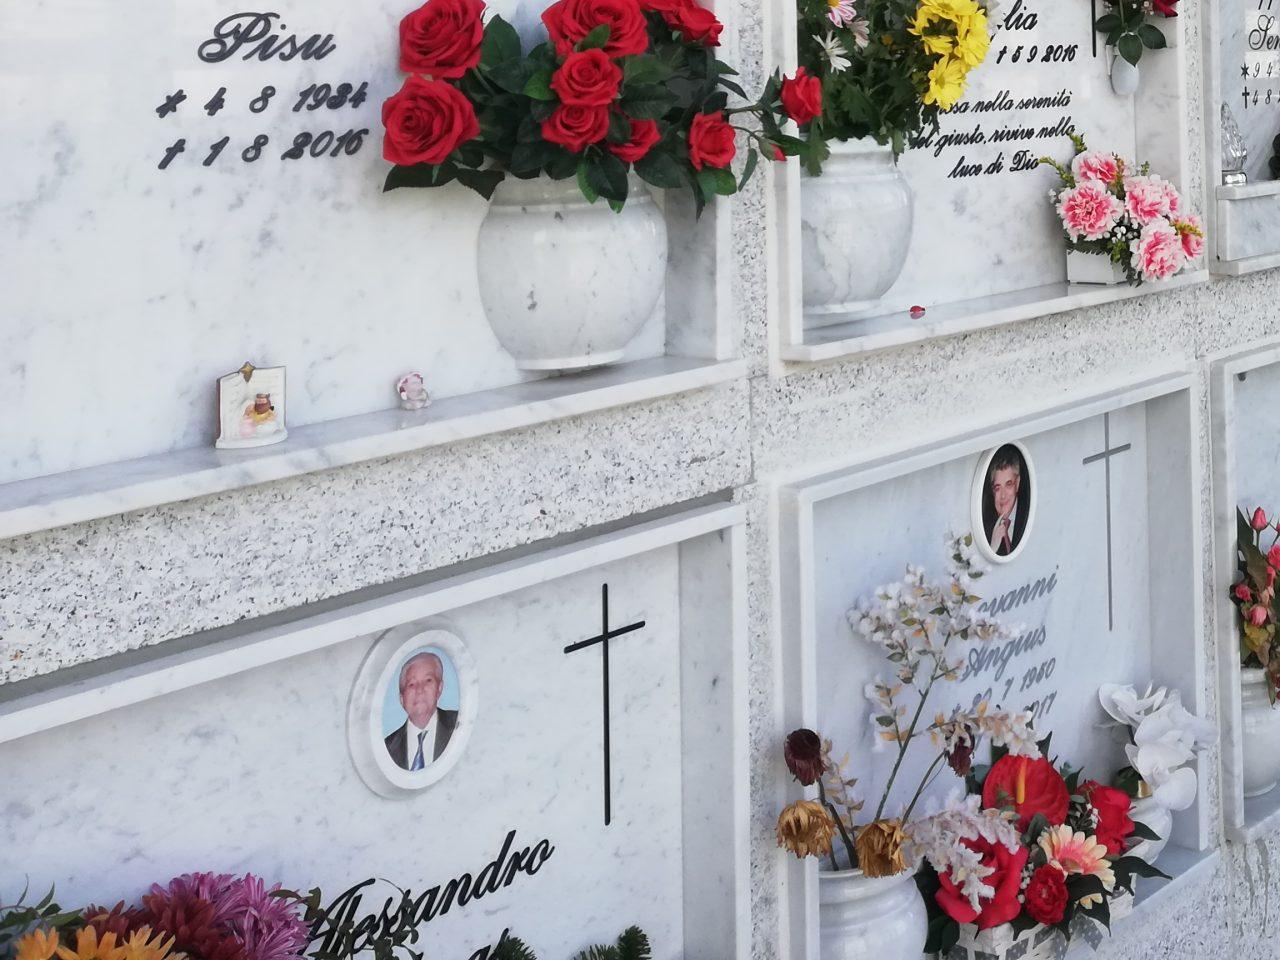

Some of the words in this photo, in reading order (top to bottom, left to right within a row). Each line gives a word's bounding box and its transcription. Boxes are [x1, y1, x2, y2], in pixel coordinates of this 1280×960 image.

[197, 12, 337, 64] Pisu
[1012, 45, 1025, 63] 5
[1026, 45, 1038, 64] 9
[1041, 44, 1079, 63] 2016
[1253, 61, 1261, 78] 9
[1266, 62, 1274, 78] 4
[204, 86, 227, 116] 4
[249, 85, 276, 114] 8
[971, 90, 1014, 113] nella
[1015, 88, 1073, 110] serenità
[1252, 89, 1259, 106] 4
[1265, 88, 1272, 105] 8
[988, 124, 1035, 144] rivive
[1035, 116, 1076, 138] nella
[202, 136, 230, 167] 1
[241, 134, 269, 163] 8
[280, 128, 370, 161] 2016
[947, 155, 983, 178] luce
[983, 152, 1004, 175] di
[1009, 150, 1040, 172] Dio
[959, 623, 1047, 682] Angius
[1002, 677, 1015, 701] 7
